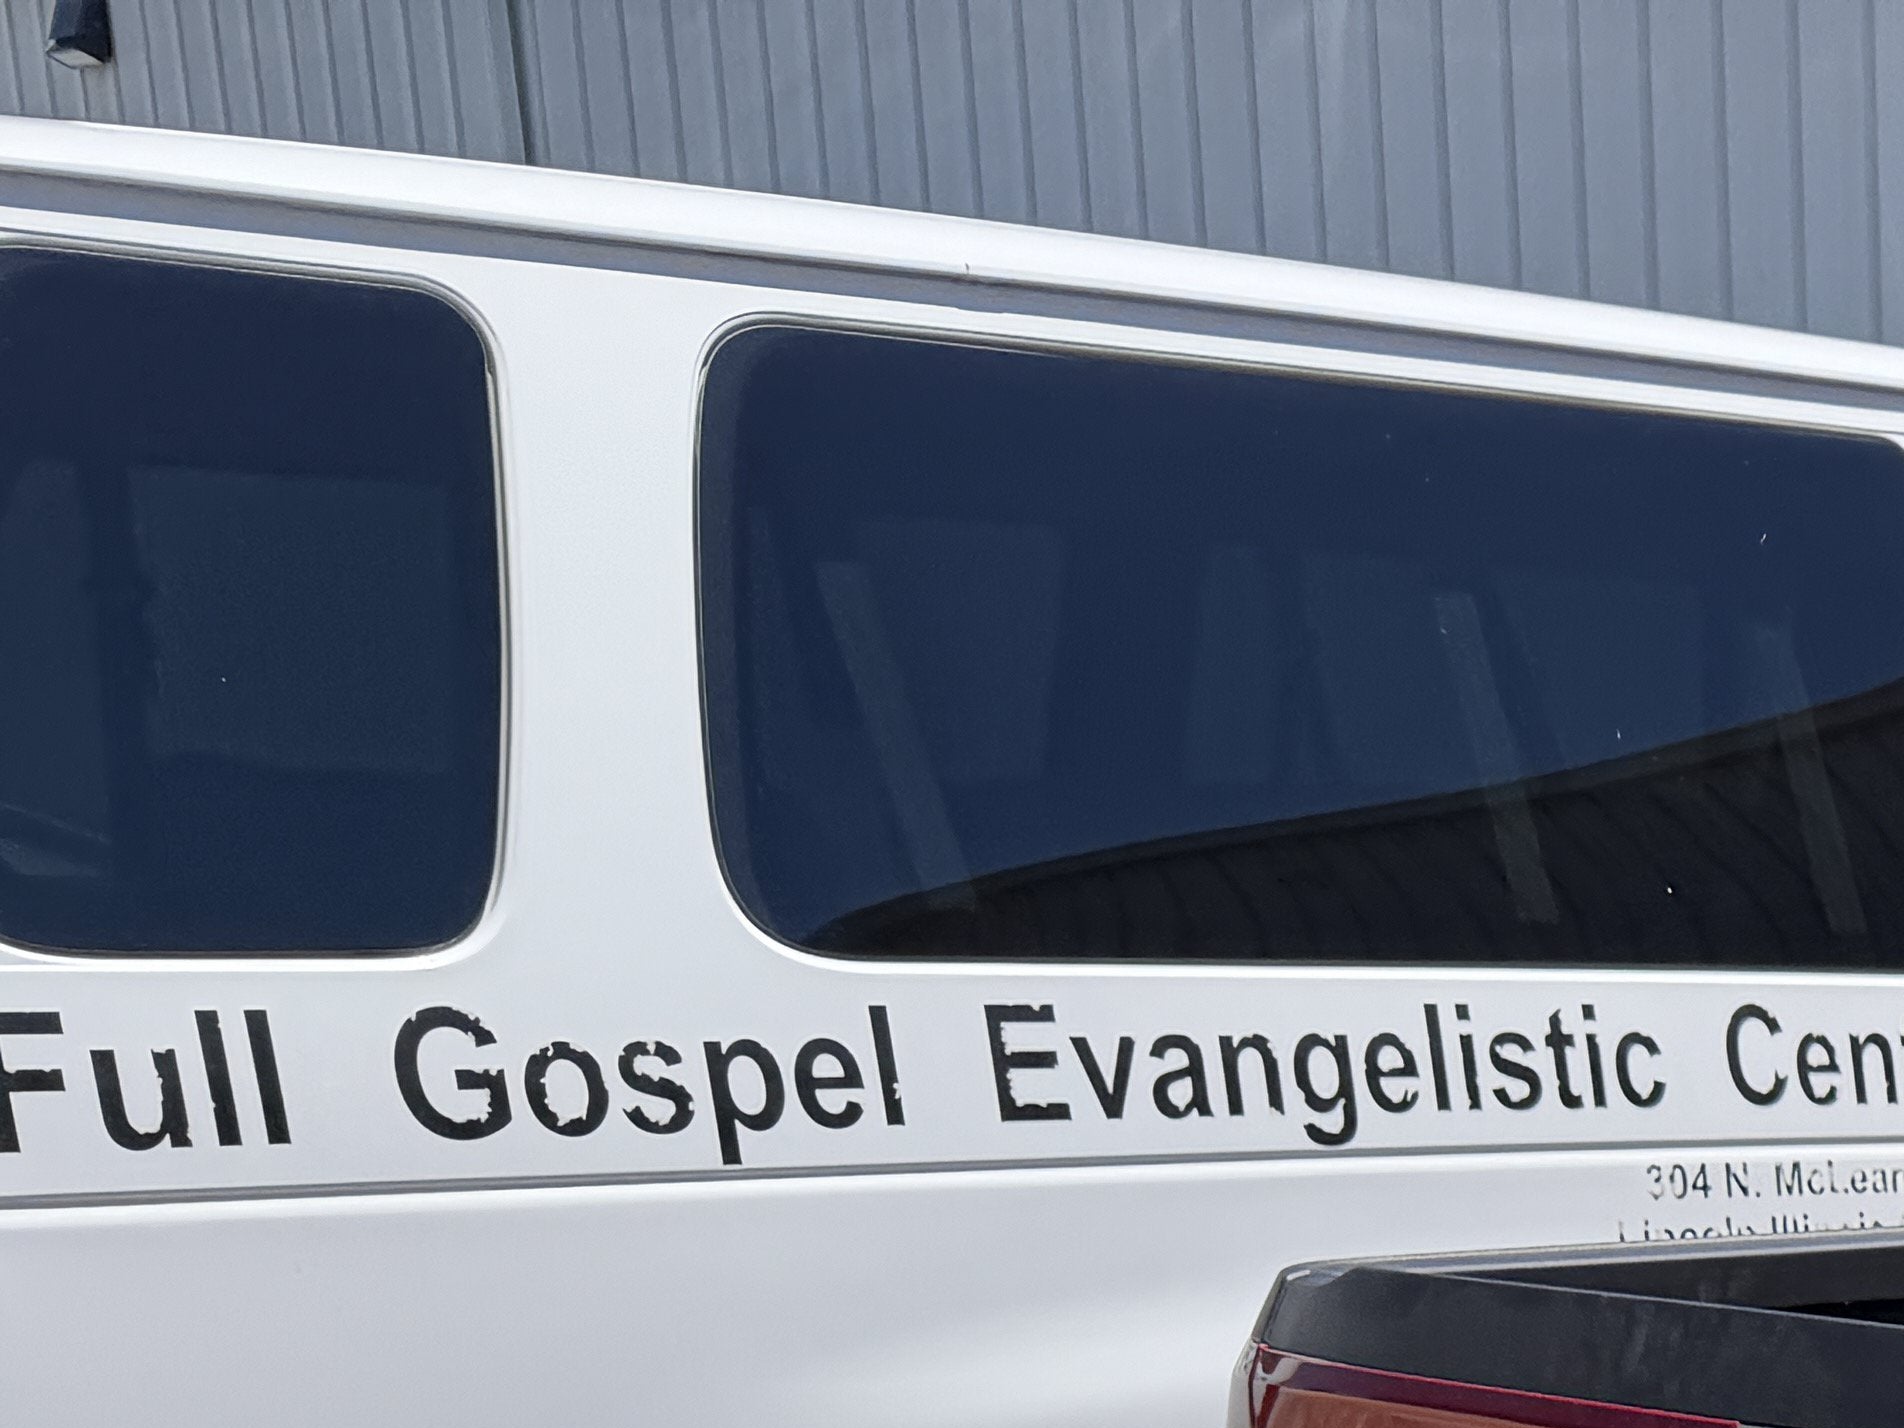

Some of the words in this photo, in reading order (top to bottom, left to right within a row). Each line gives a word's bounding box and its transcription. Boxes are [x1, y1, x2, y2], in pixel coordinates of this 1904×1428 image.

[0, 1008, 292, 1154] Full
[394, 1005, 906, 1166] Gospel
[983, 1003, 1666, 1145] Evangelistic
[1646, 1162, 1713, 1201] 304
[1725, 1162, 1761, 1199] N.
